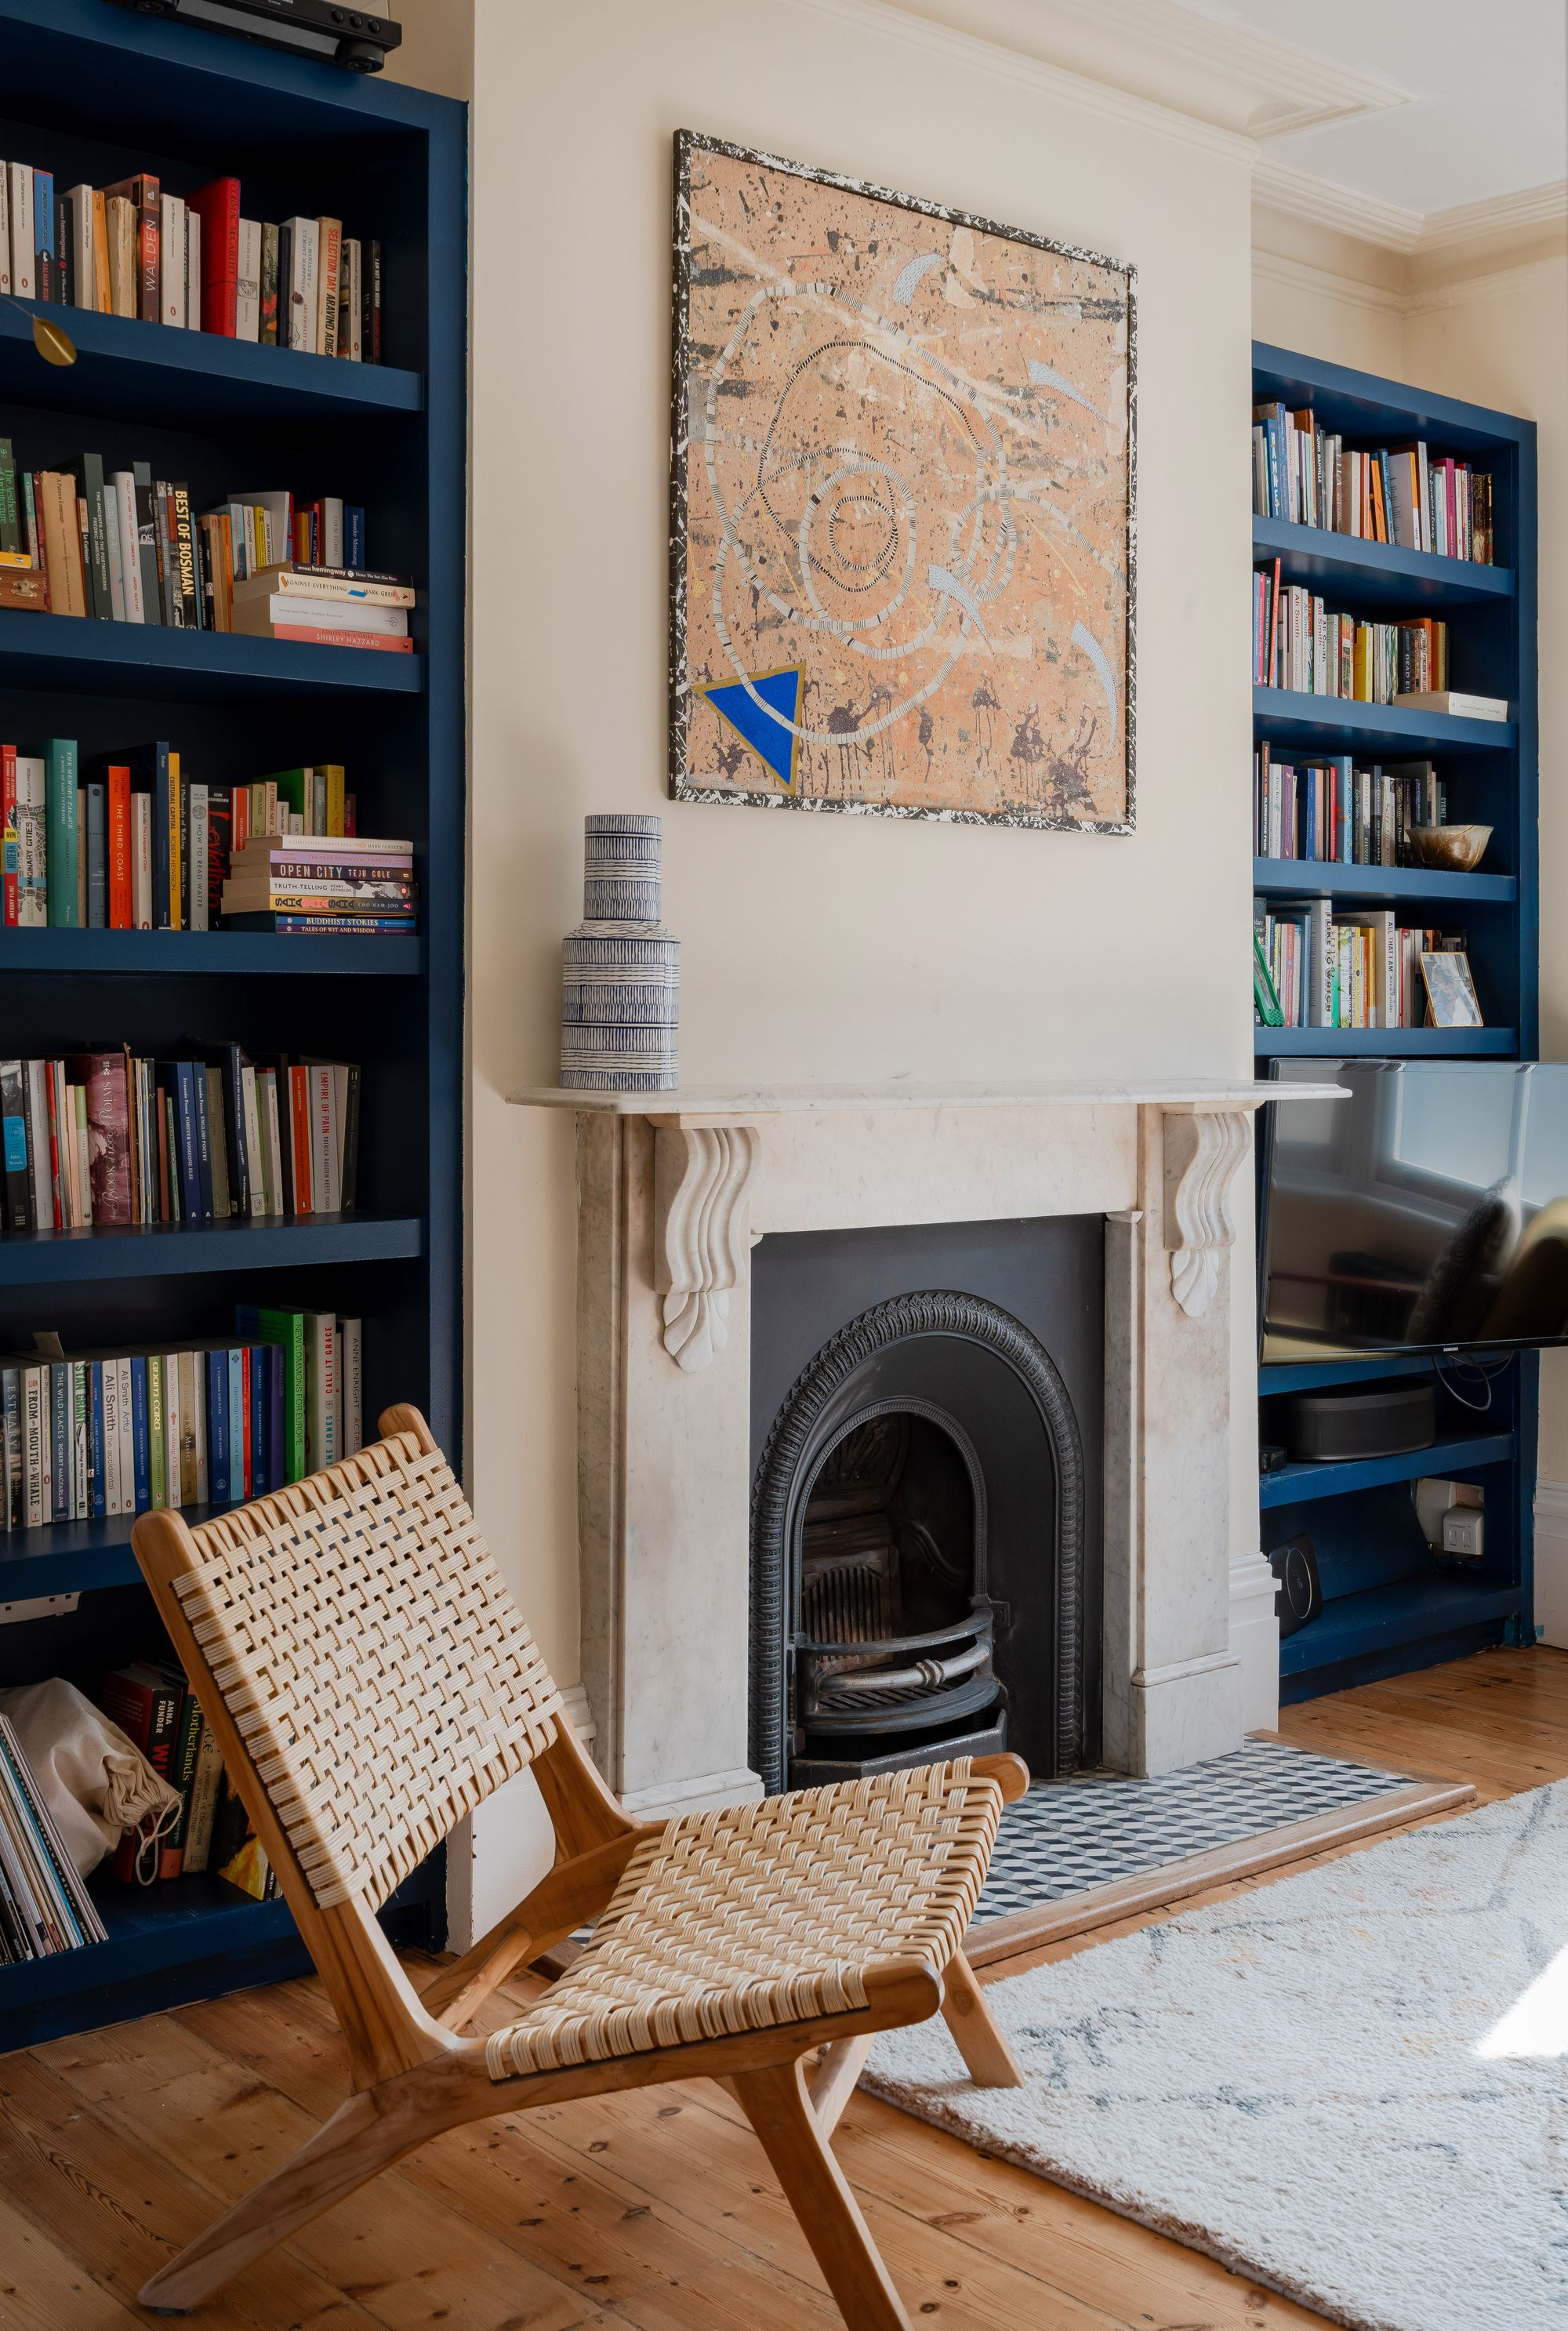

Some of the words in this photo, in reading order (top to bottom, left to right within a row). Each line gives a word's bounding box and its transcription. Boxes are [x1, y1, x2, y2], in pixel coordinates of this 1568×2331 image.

[146, 220, 157, 292] WALDEN
[328, 228, 338, 274] SELECTION
[327, 275, 336, 292] DAY
[325, 293, 336, 330] ARAVIND
[5, 470, 14, 485] The
[1271, 432, 1280, 516] HAMNET
[6, 487, 16, 524] Aesthetics
[174, 491, 189, 520] BEST
[141, 534, 153, 544] 05
[178, 523, 191, 539] OF
[179, 543, 194, 595] BOSMAN
[312, 566, 346, 577] hemingway
[287, 579, 311, 589] AGAINST
[312, 583, 347, 592] EVERYTHING
[316, 634, 343, 643] SHIRLEY
[346, 637, 379, 647] HAZZARD
[198, 847, 202, 857] TO
[280, 865, 310, 877] OPEN
[317, 866, 343, 878] CITY
[348, 869, 367, 877] TEJU
[1326, 950, 1331, 966] TO
[1388, 961, 1393, 971] AM
[322, 1104, 329, 1113] OF
[326, 1360, 332, 1369] IT
[75, 1364, 86, 1391] STAN
[105, 1375, 114, 1391] Ali
[29, 1390, 39, 1419] FROM
[106, 1394, 115, 1432] Smith
[29, 1427, 39, 1465] MOUTH
[31, 1473, 40, 1506] WHALE
[155, 1700, 166, 1735] FUNDER
[165, 1700, 175, 1726] ANNA
